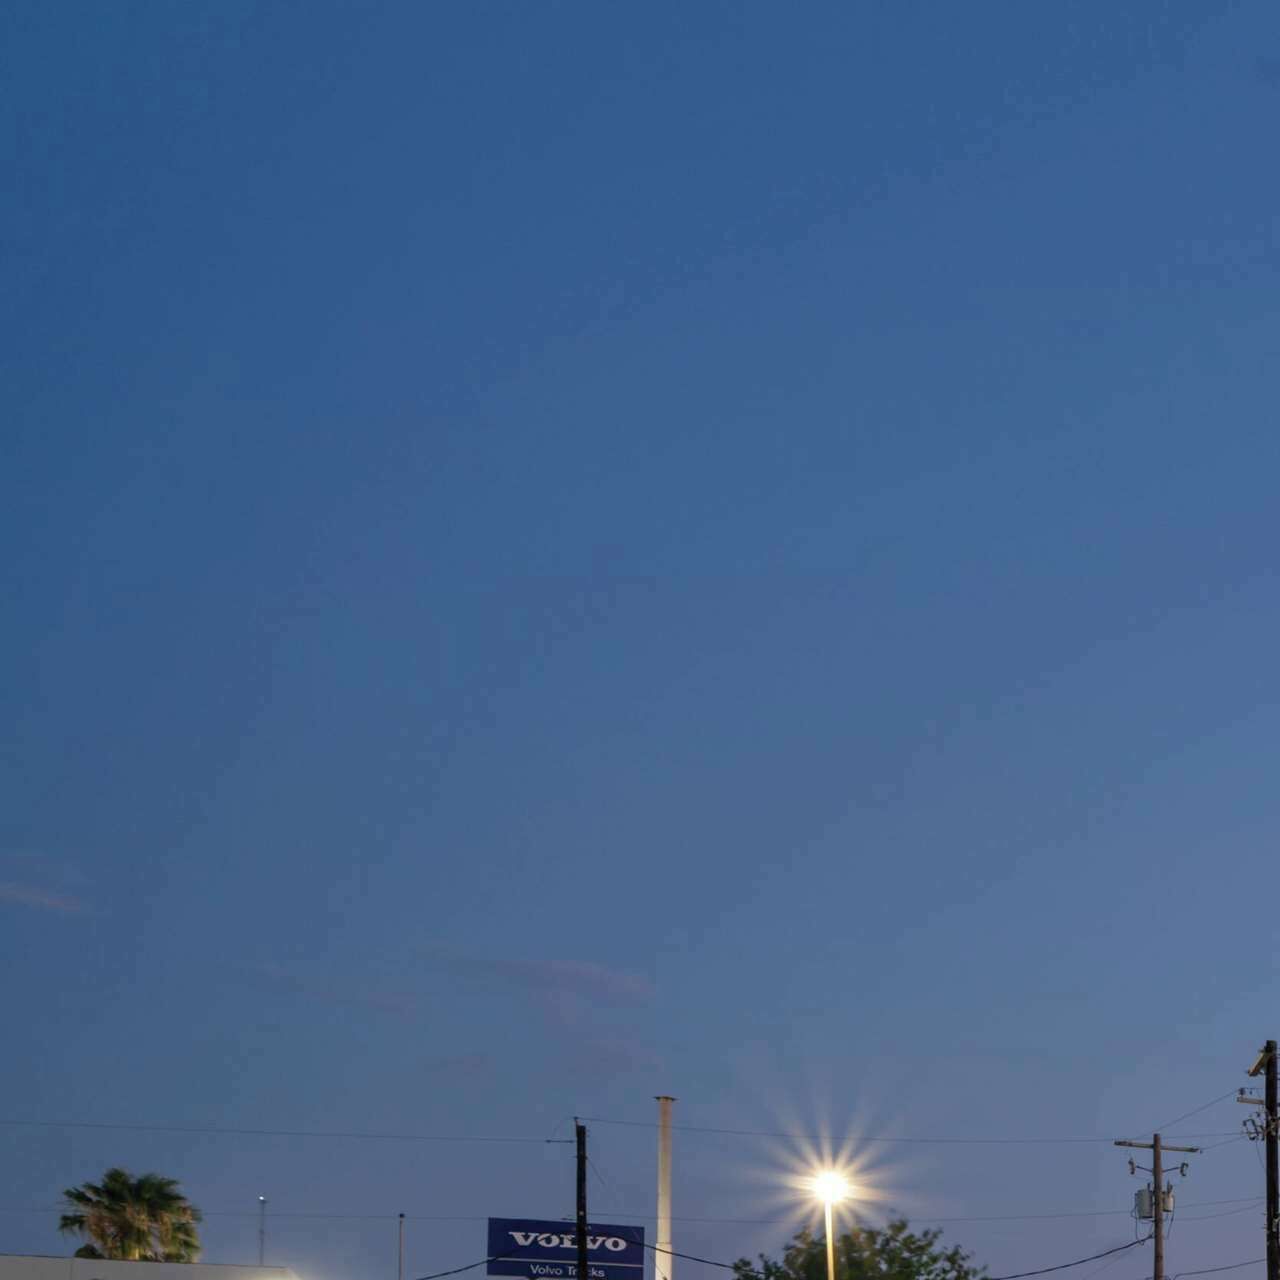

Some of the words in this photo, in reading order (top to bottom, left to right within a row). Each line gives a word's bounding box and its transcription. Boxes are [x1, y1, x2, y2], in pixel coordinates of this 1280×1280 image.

[508, 1231, 627, 1252] VOLVO
[530, 1264, 563, 1276] Volvo
[568, 1266, 605, 1278] Trks
